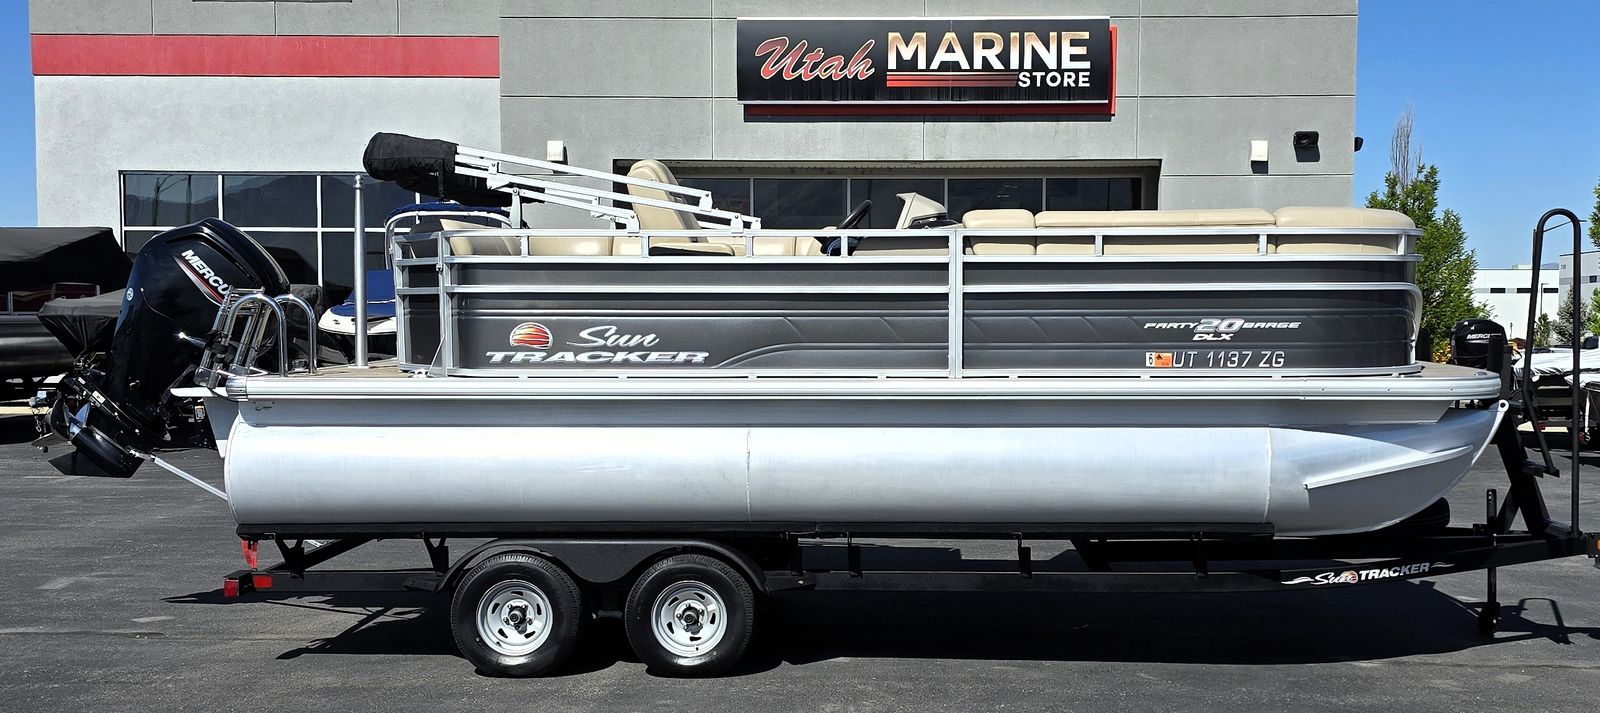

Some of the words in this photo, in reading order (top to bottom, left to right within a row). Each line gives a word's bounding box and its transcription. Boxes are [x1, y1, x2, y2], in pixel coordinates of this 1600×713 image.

[754, 36, 875, 81] Utah
[887, 31, 1091, 70] MARINE
[1018, 72, 1091, 88] STORE
[181, 249, 230, 295] MERCU
[1193, 318, 1245, 333] 20
[1242, 321, 1302, 329] BARGE
[566, 325, 660, 348] Sun
[1192, 333, 1234, 341] DLX
[486, 351, 710, 364] TRACKER
[1148, 353, 1154, 365] 6
[1172, 351, 1198, 368] UT
[1207, 351, 1253, 368] 1137
[1258, 351, 1285, 368] ZG
[1310, 571, 1354, 585] Sun
[1358, 562, 1430, 581] TRACKER
